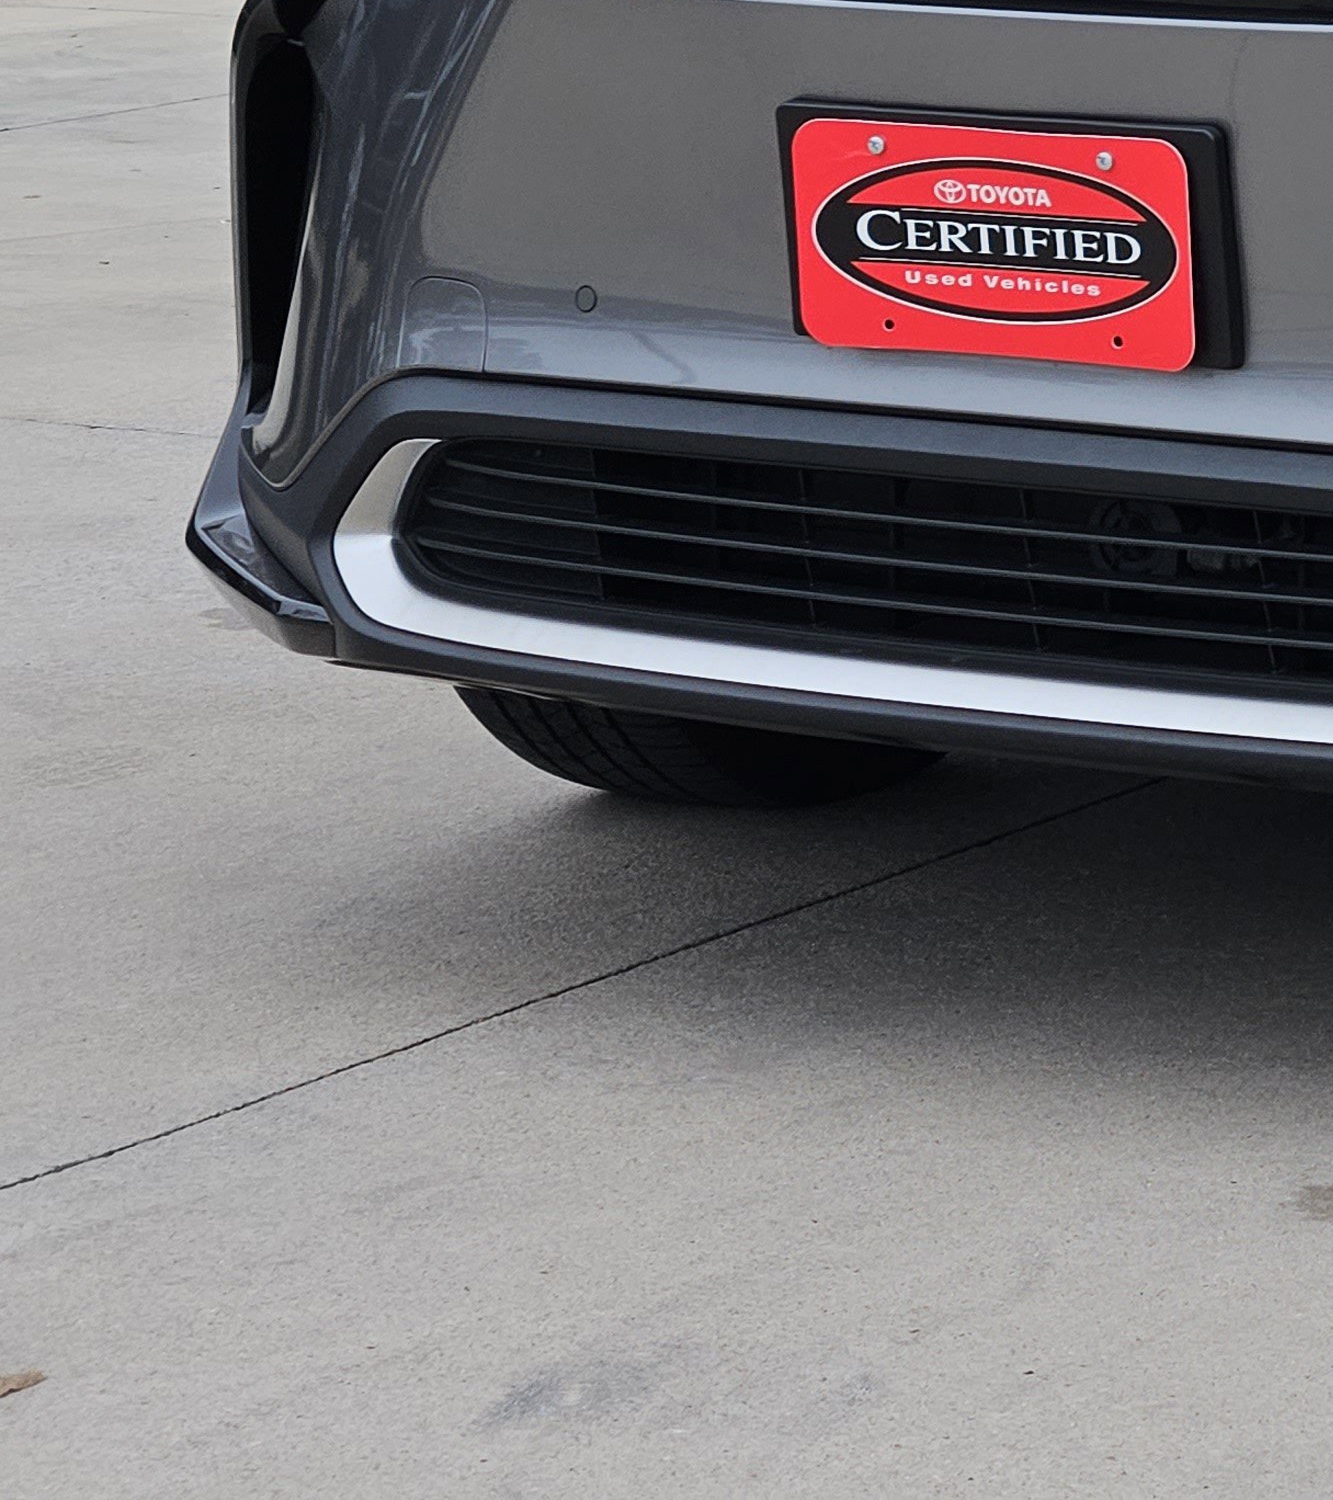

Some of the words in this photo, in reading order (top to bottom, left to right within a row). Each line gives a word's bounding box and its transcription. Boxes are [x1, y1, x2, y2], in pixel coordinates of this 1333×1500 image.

[965, 183, 1052, 208] TOYOTA
[855, 209, 1142, 265] CERTIFIED
[904, 269, 973, 288] Used
[984, 274, 1102, 297] Vehicles
